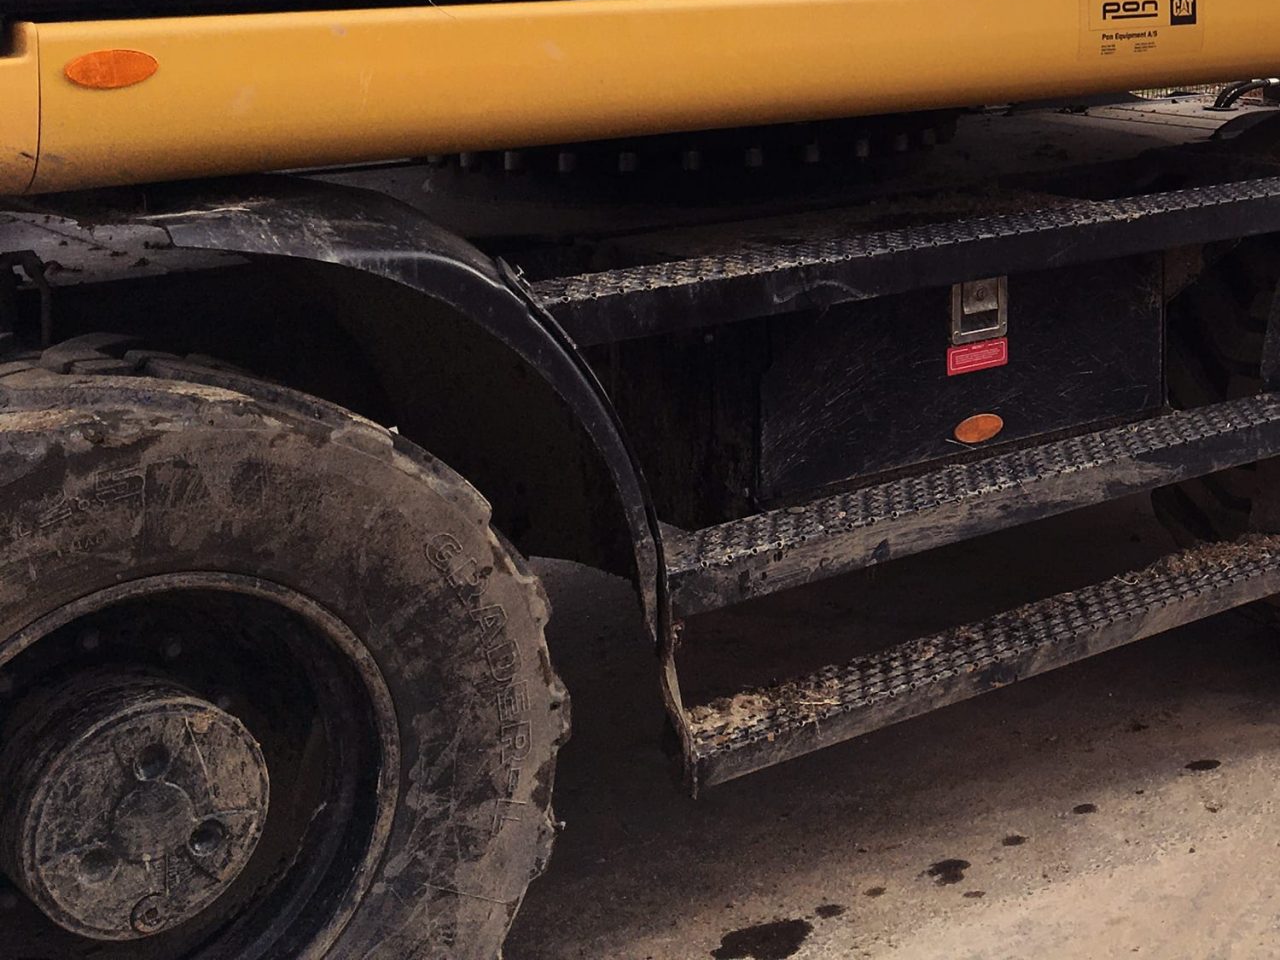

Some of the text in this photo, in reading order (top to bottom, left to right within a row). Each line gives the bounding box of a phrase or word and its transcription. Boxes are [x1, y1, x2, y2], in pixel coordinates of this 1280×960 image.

[1102, 0, 1158, 20] pon
[1115, 31, 1146, 40] Equipment
[1148, 30, 1158, 38] A/S
